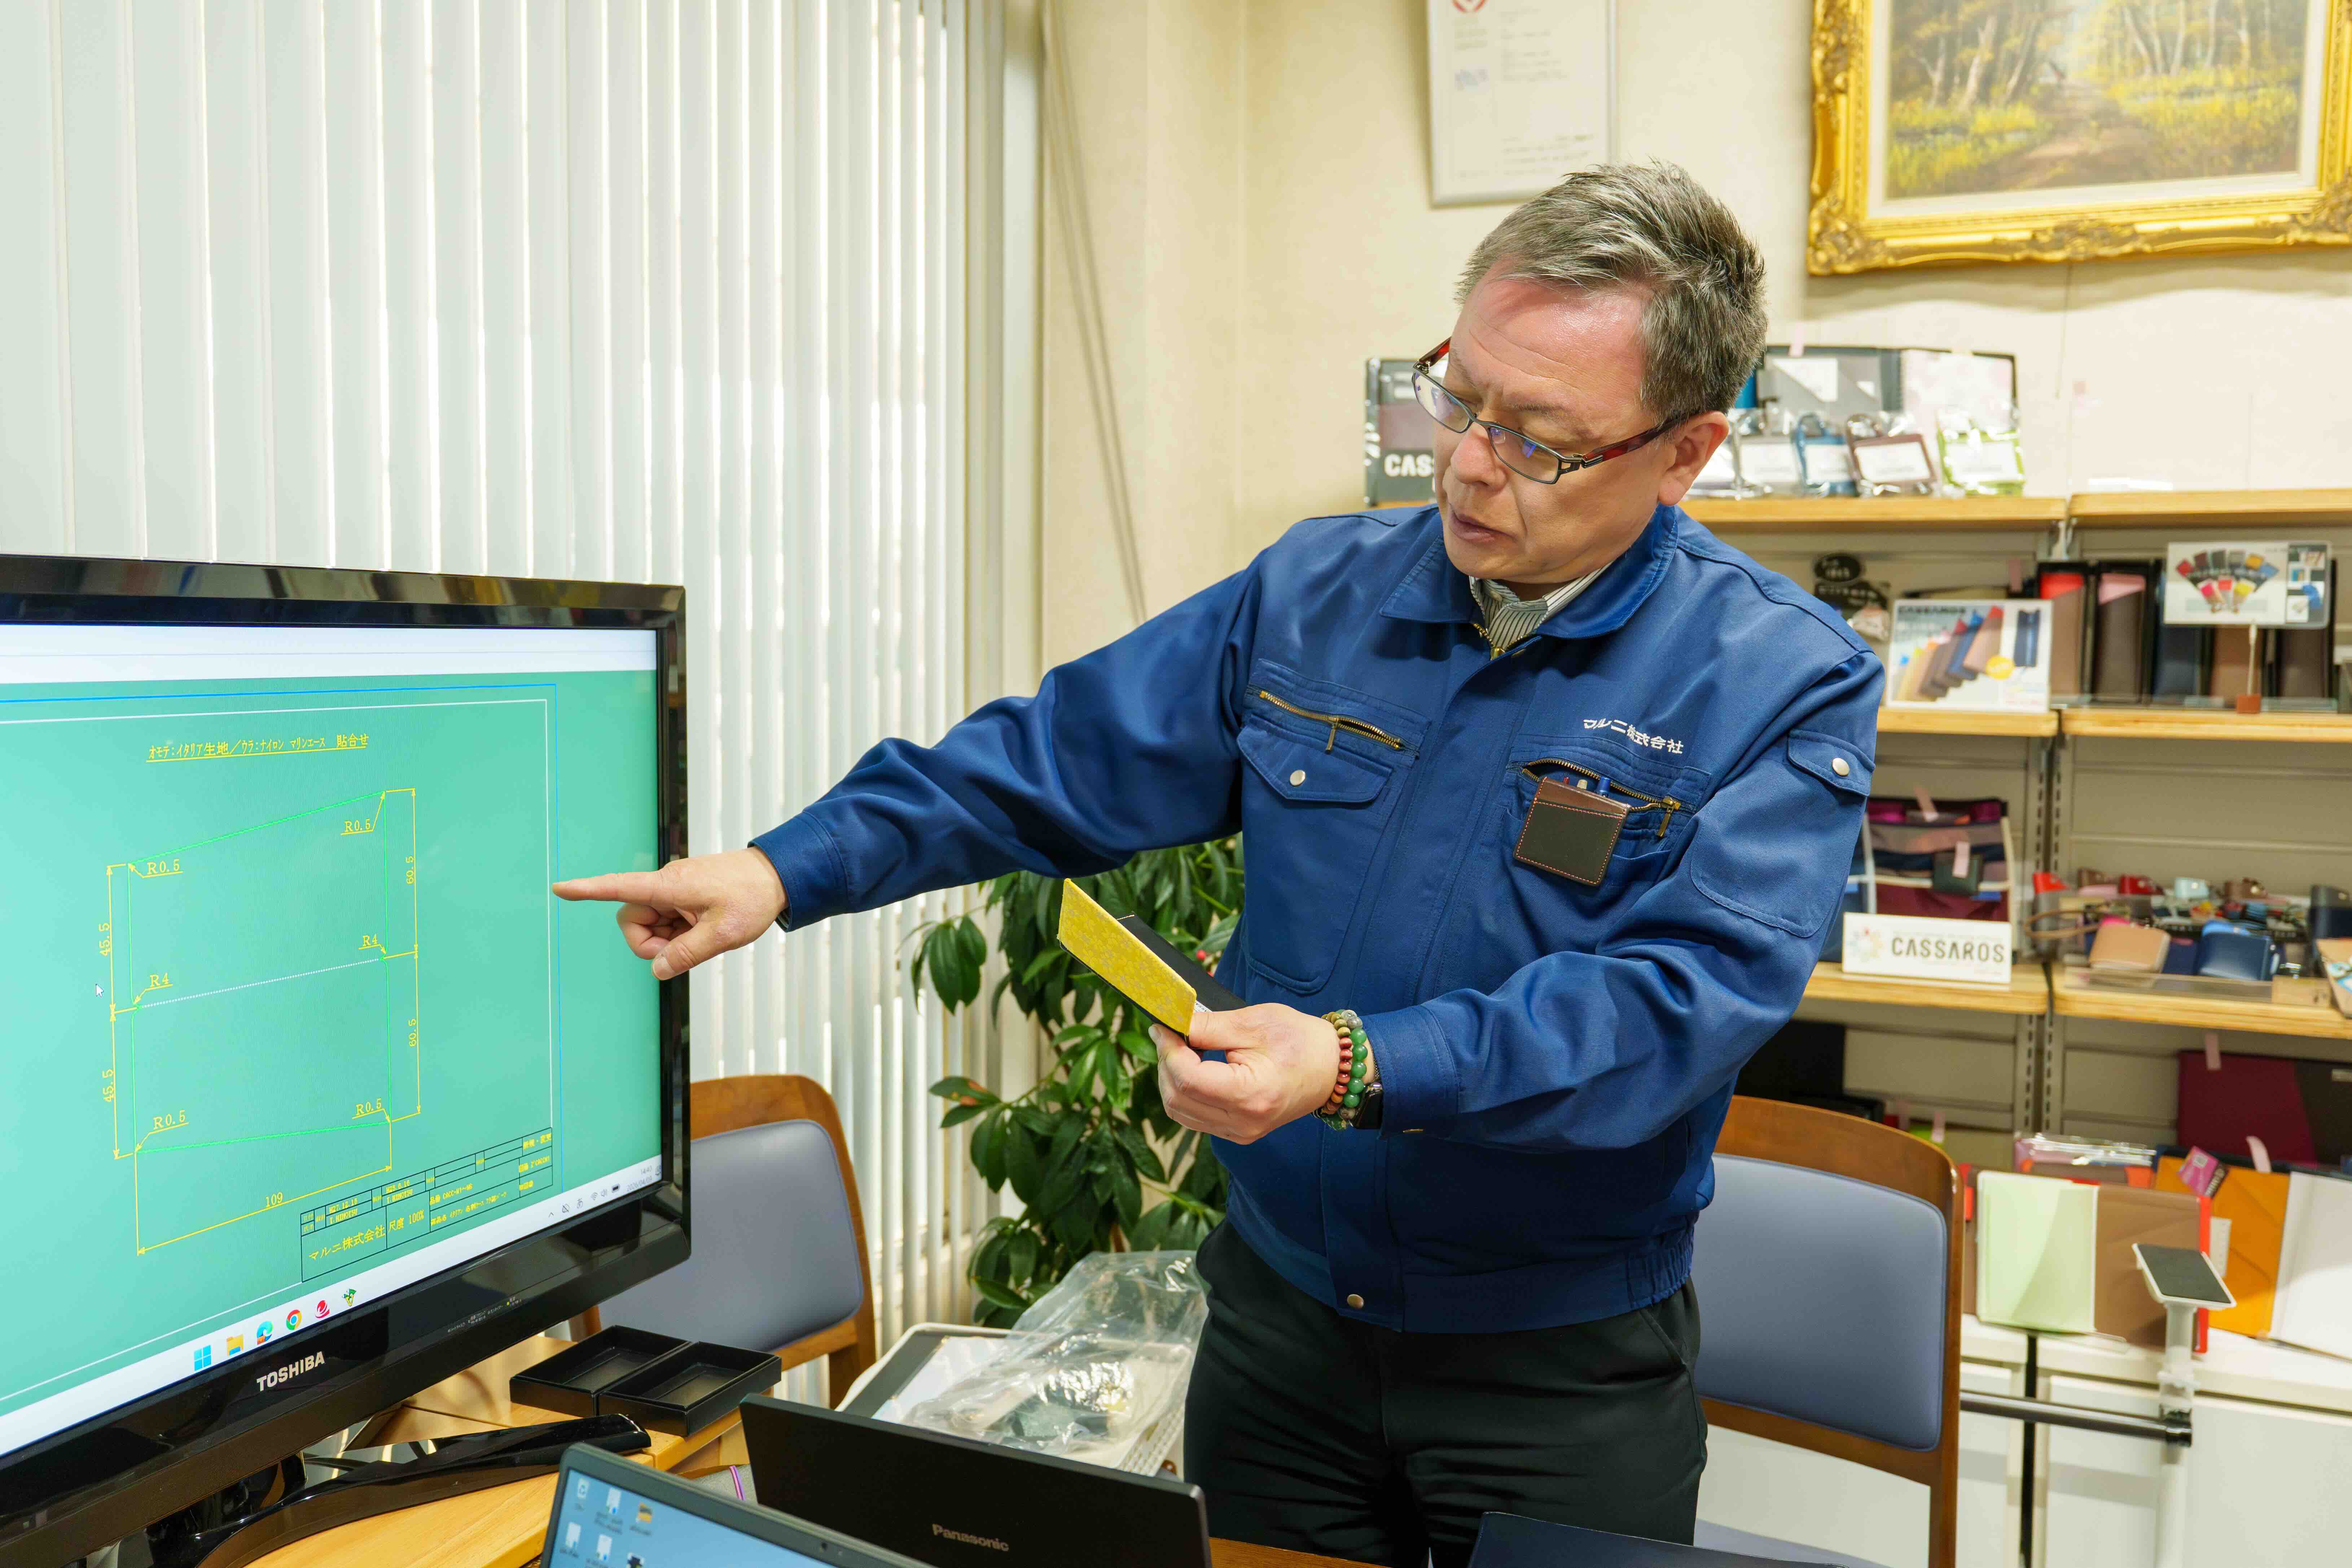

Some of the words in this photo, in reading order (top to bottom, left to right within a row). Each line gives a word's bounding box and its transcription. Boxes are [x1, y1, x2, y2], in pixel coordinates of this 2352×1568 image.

[1384, 454, 1434, 477] CAS
[290, 737, 325, 750] マリンエース
[336, 733, 369, 747] 貼合せ
[1583, 718, 1684, 754] マルニ株式会社
[344, 818, 371, 833] R0.5
[147, 859, 180, 875] R0.5
[98, 923, 110, 956] 45.5
[362, 934, 378, 947] R4
[1891, 936, 2005, 963] CASSAROS
[150, 972, 170, 987] R4
[102, 1068, 114, 1103] 45.5
[356, 1098, 382, 1115] R0.5
[153, 1110, 186, 1130] R0.5
[266, 1192, 283, 1208] 109
[389, 1217, 404, 1232] 尺度
[309, 1225, 386, 1260] マルニ株式会社
[256, 1351, 325, 1392] TOSHIBA
[932, 1523, 1009, 1551] Panasonic
